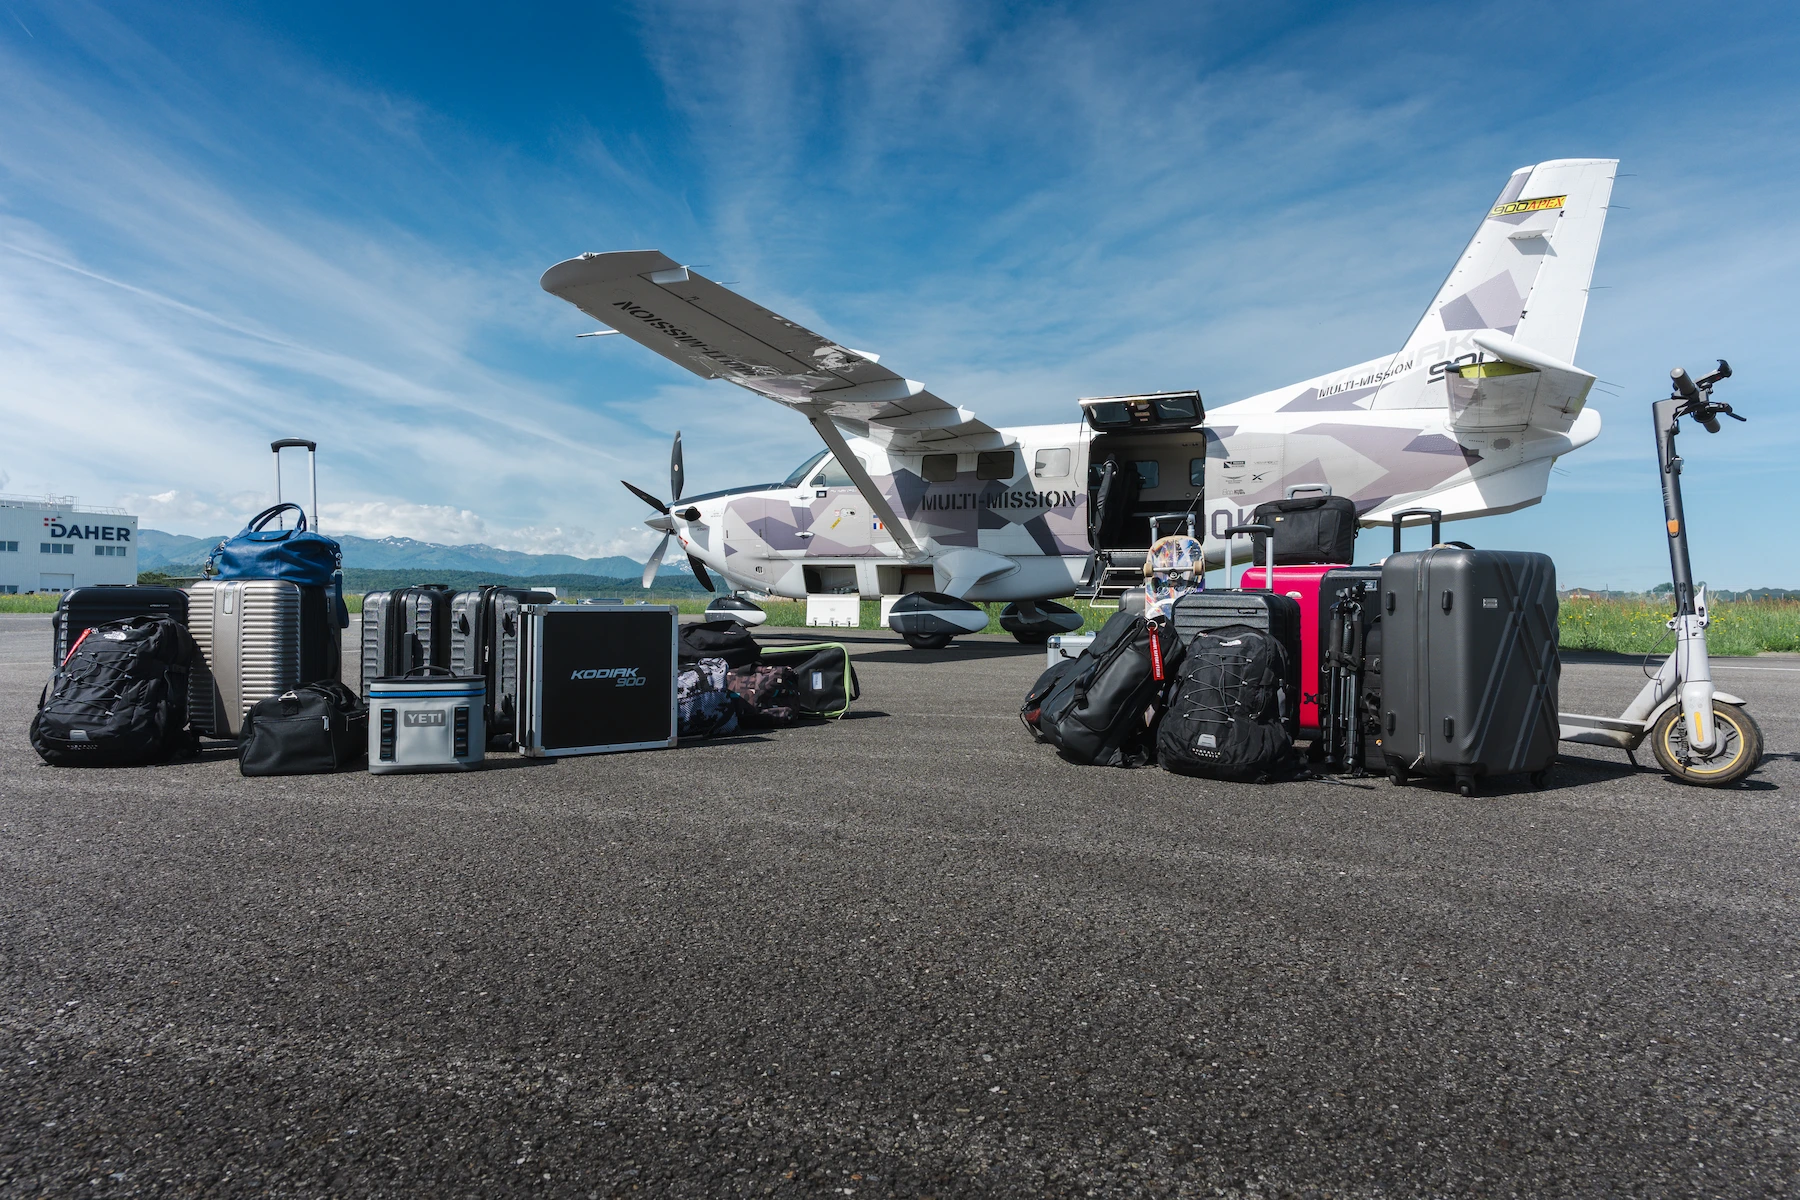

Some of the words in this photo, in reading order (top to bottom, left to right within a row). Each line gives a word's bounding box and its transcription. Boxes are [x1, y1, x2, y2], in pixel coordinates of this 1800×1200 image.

[1491, 197, 1565, 215] 900APEX
[1318, 360, 1414, 398] MULTI-MISSION
[921, 490, 1077, 511] MULTI-MISSION
[51, 523, 131, 542] DAHER
[570, 667, 640, 680] KODIAK
[614, 676, 647, 688] 900
[407, 713, 442, 724] YETI
